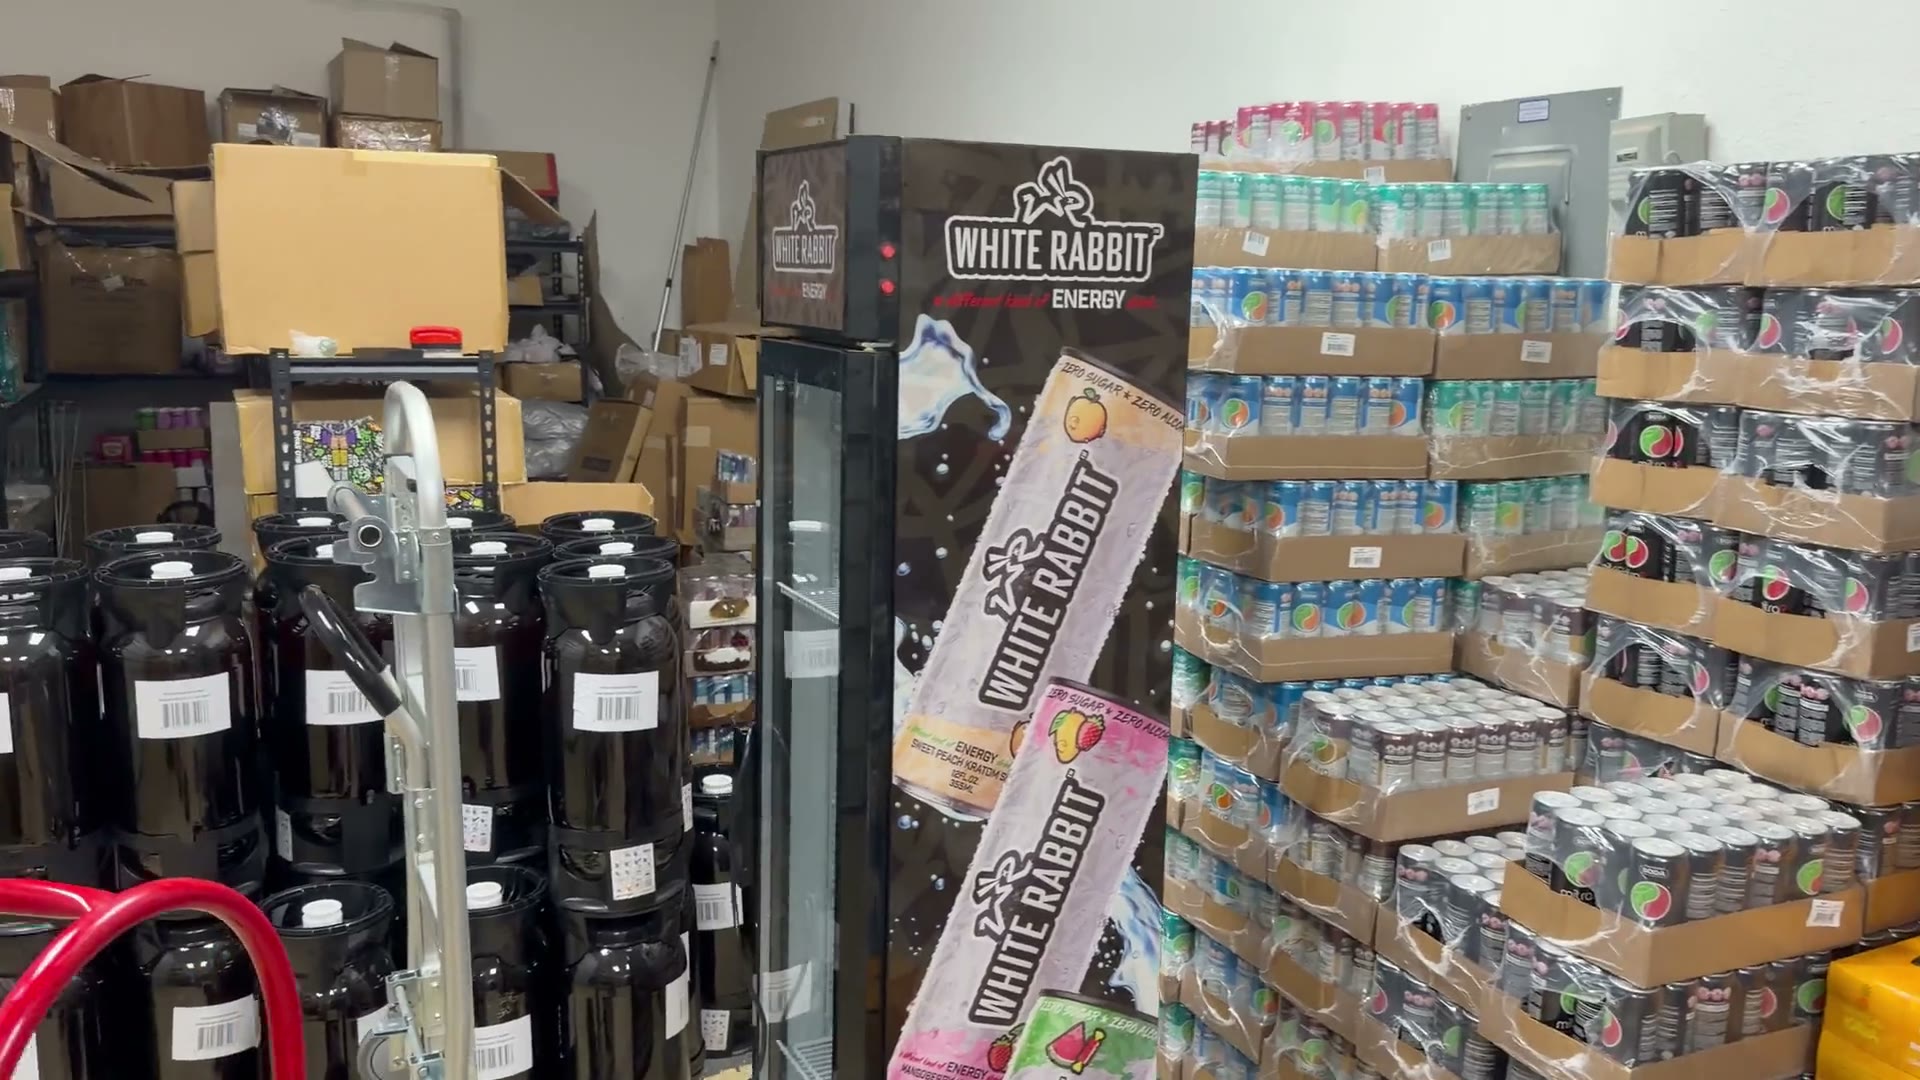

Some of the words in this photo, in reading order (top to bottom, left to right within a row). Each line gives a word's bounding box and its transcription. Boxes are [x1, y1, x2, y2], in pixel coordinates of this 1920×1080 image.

[775, 235, 800, 264] WHITE
[801, 234, 834, 265] RABBIT
[954, 226, 1043, 270] WHITE
[1049, 230, 1149, 272] RABBIT
[1052, 288, 1127, 309] ENERGY
[1061, 361, 1085, 378] ZERO
[1085, 371, 1124, 395] SUGAR
[1131, 395, 1161, 417] ZERO
[984, 596, 1062, 705] WHITE
[1031, 466, 1114, 599] RABBIT
[1047, 687, 1069, 702] ZERO
[1068, 693, 1105, 712] SUGAR
[1112, 710, 1143, 729] ZERO
[911, 738, 937, 756] SWEET
[935, 748, 964, 767] PEACH
[963, 758, 1001, 778] KRATOM
[955, 740, 999, 764] ENERGY
[975, 914, 1050, 1020] WHITE
[1020, 784, 1100, 913] RABBIT
[1062, 1005, 1102, 1022] SAR
[1109, 1016, 1138, 1033] ZERO
[946, 1061, 989, 1080] ENERGY
